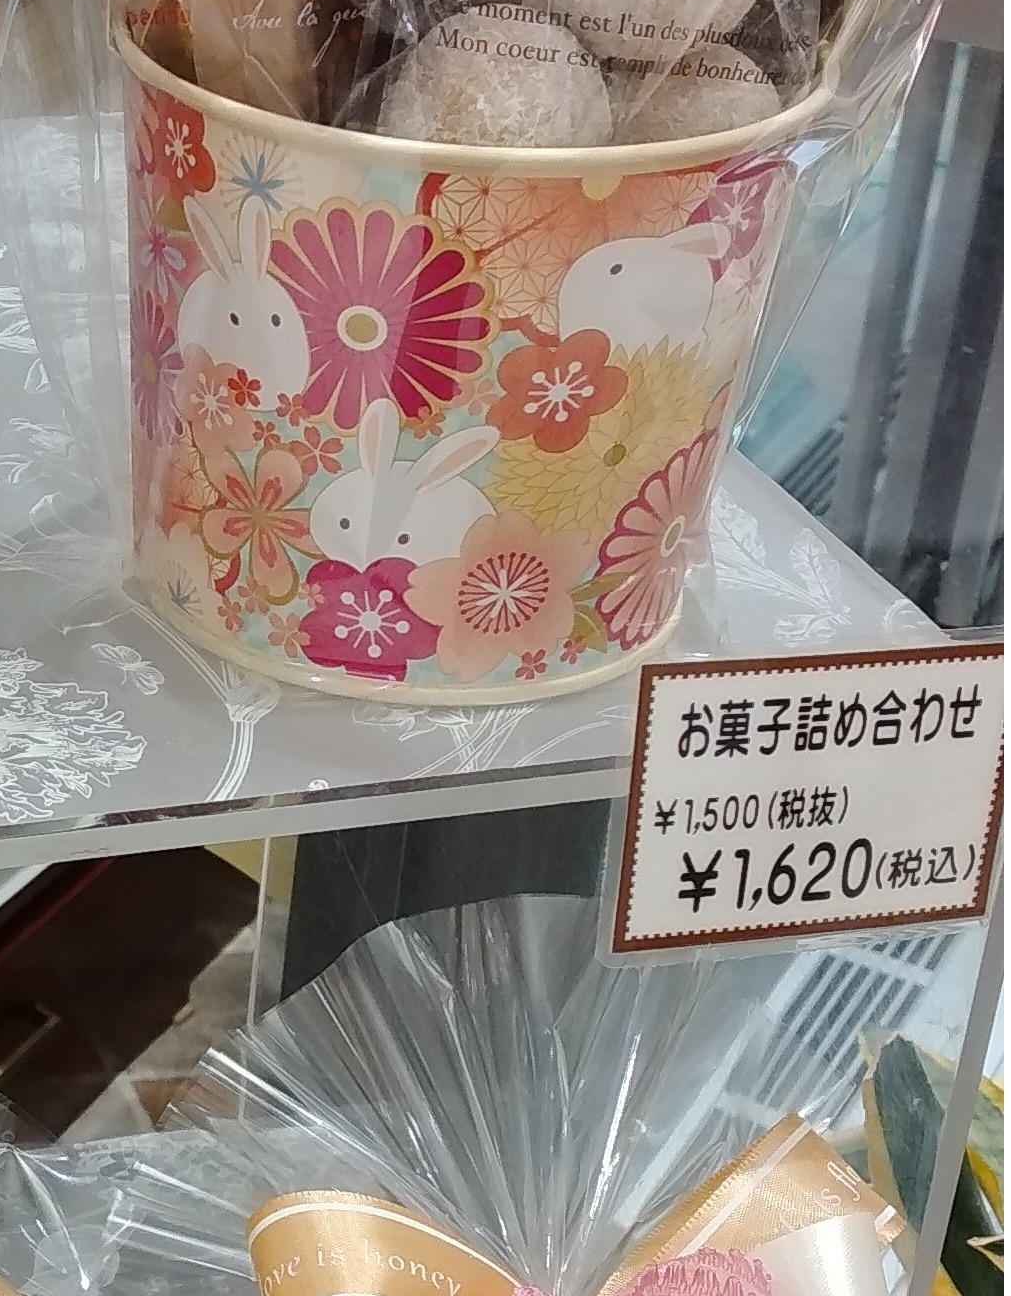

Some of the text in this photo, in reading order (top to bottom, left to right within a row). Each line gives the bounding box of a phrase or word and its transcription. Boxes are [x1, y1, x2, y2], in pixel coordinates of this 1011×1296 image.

[579, 14, 612, 34] est
[619, 13, 656, 40] l'un
[660, 19, 689, 42] des
[436, 25, 489, 55] Mon
[496, 40, 562, 63] coeur
[567, 51, 599, 68] est
[670, 56, 692, 77] de
[678, 684, 983, 759] お菓子詰め合わせ
[317, 1243, 347, 1267] is
